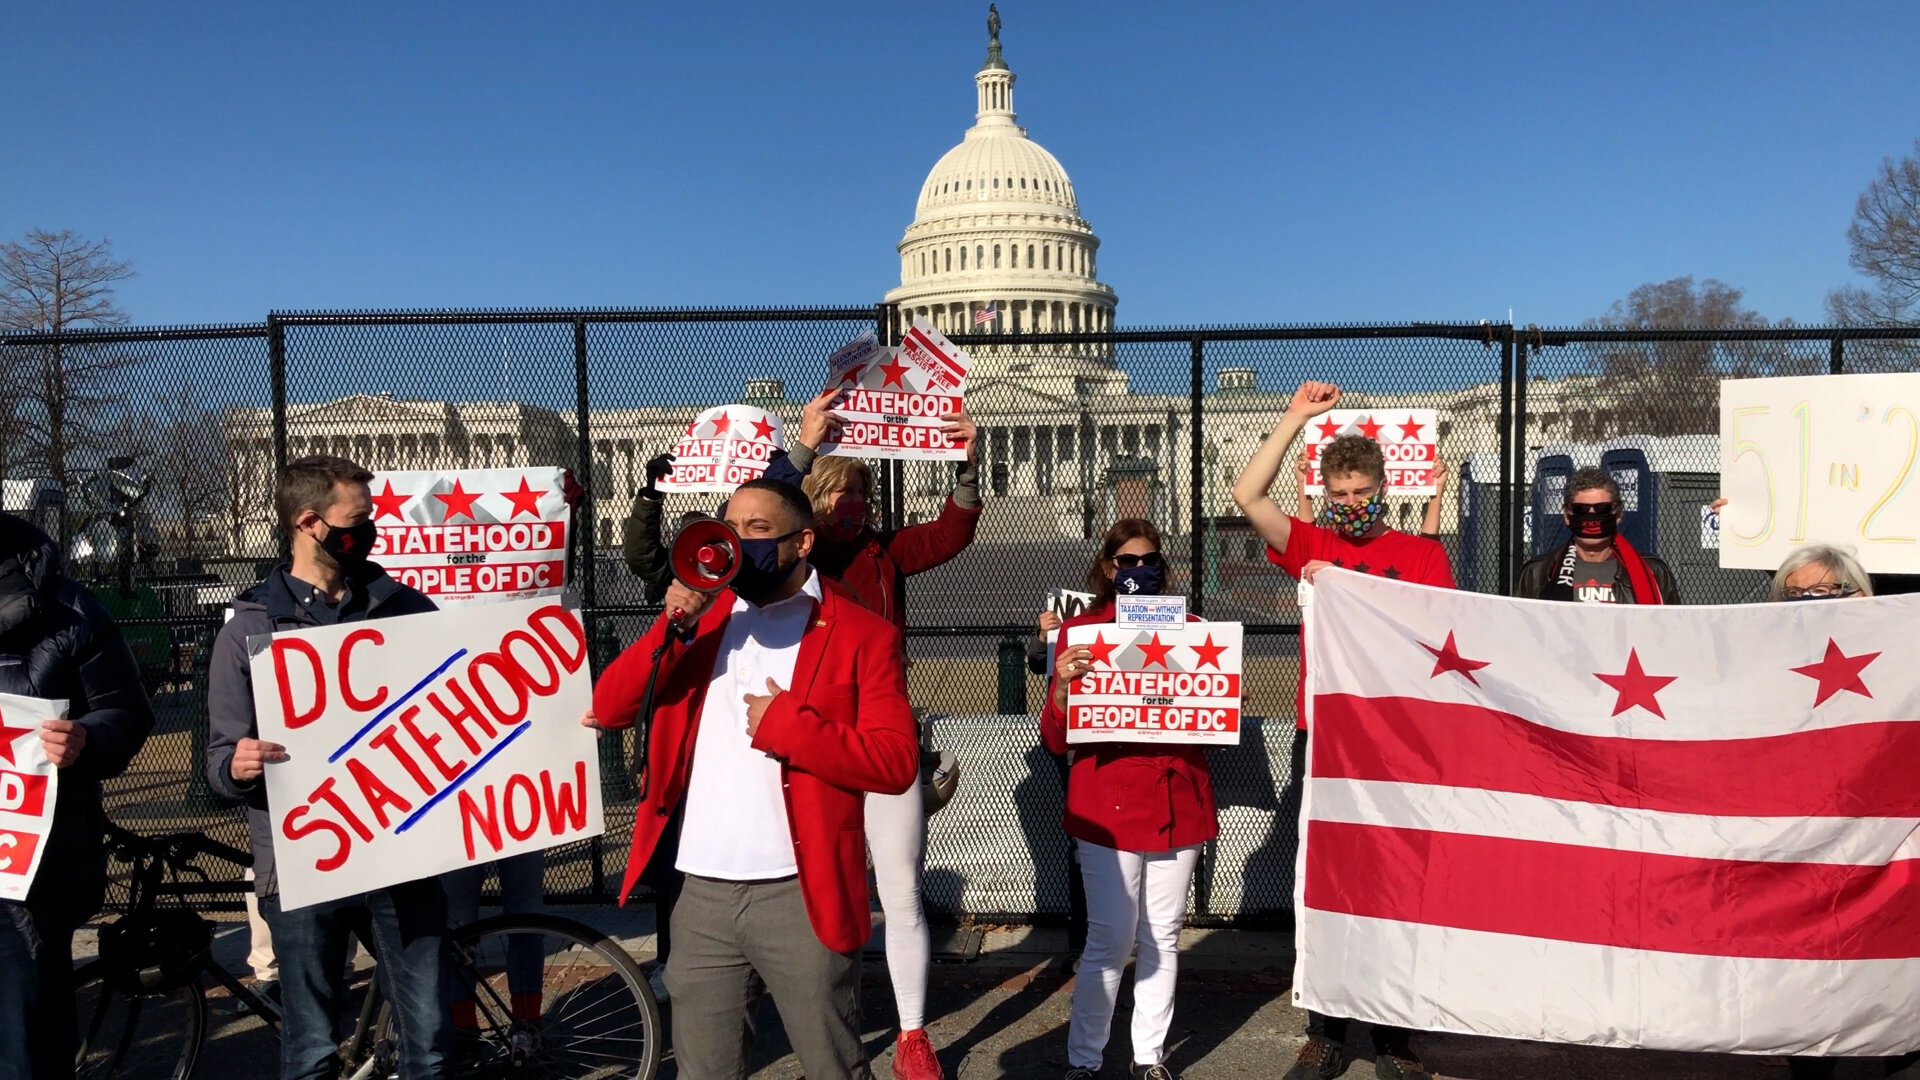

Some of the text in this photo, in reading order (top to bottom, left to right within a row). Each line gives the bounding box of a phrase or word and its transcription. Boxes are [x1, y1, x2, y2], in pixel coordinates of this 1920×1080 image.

[903, 347, 951, 390] FASCIST FREE
[883, 415, 908, 424] for the
[902, 427, 926, 447] OF
[727, 466, 751, 484] OF
[1404, 470, 1426, 485] DC
[1725, 401, 1809, 545] 51
[1829, 462, 1860, 491] IN
[370, 524, 552, 554] STATEHOOD
[446, 554, 486, 564] for the
[476, 566, 513, 591] OF
[517, 564, 550, 588] DC
[1120, 605, 1182, 614] TAXATION WITHOUT
[1128, 614, 1175, 622] REPRESENTATION
[271, 628, 388, 730] DC
[1080, 672, 1229, 696] STATEHOOD
[1142, 696, 1174, 705] for the
[1078, 706, 1226, 731] PEOPLE OF DC
[282, 605, 587, 872] STATEHOOD
[458, 761, 587, 860] NOW
